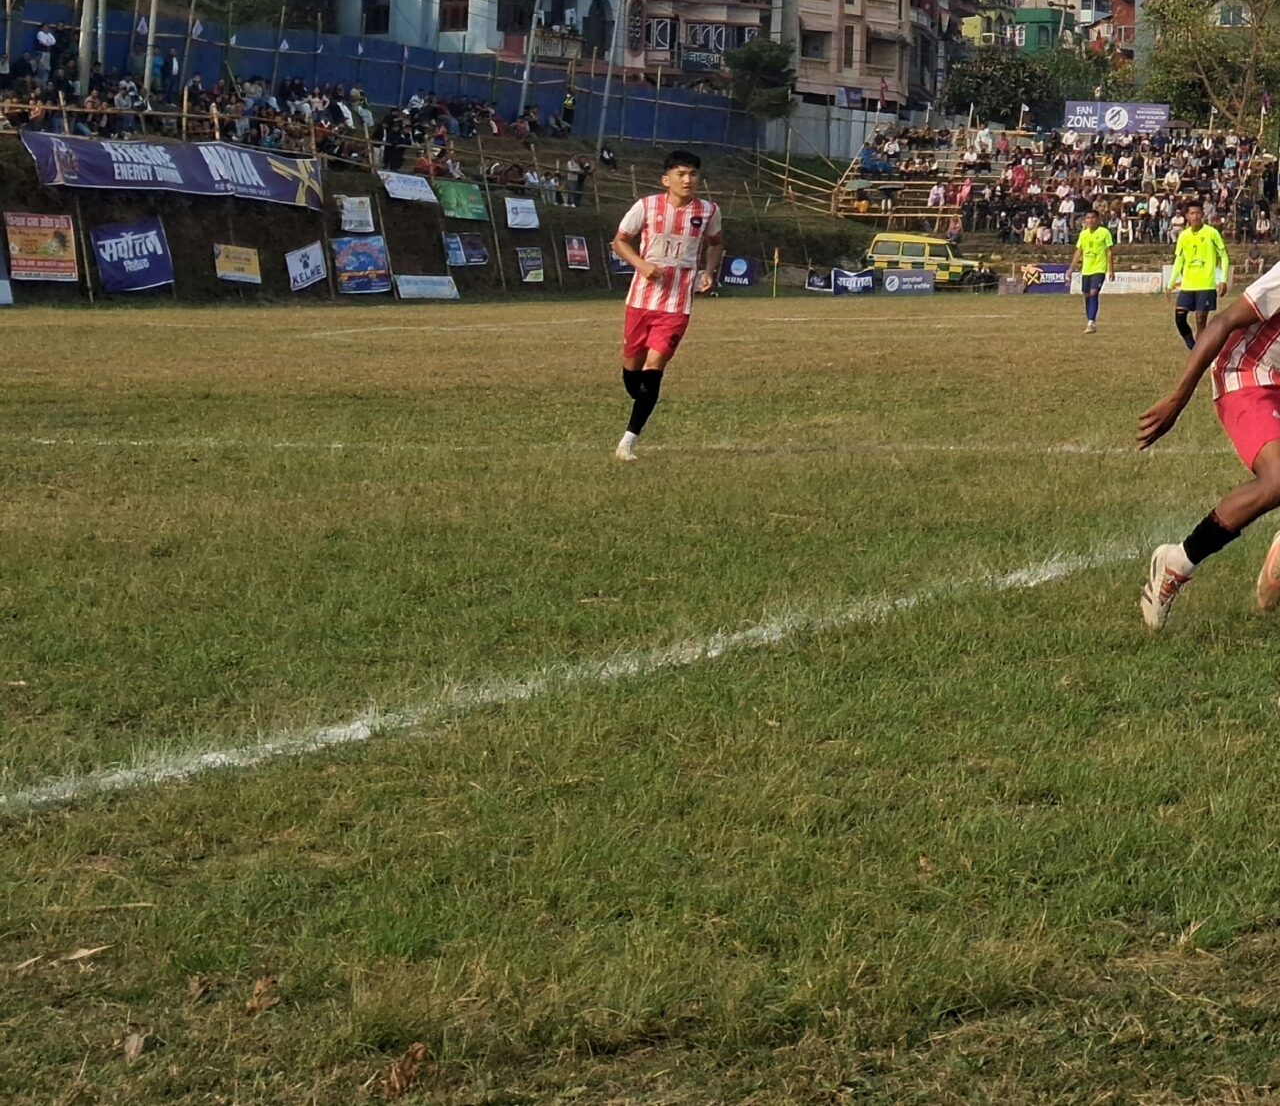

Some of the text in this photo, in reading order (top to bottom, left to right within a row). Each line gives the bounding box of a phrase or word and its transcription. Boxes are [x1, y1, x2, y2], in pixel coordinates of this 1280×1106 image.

[1076, 106, 1093, 114] FAN
[1066, 116, 1099, 128] ZONE
[100, 142, 177, 168] XTREME
[113, 163, 152, 180] ENERGY
[292, 265, 322, 285] KELME
[724, 276, 749, 285] NRNA
